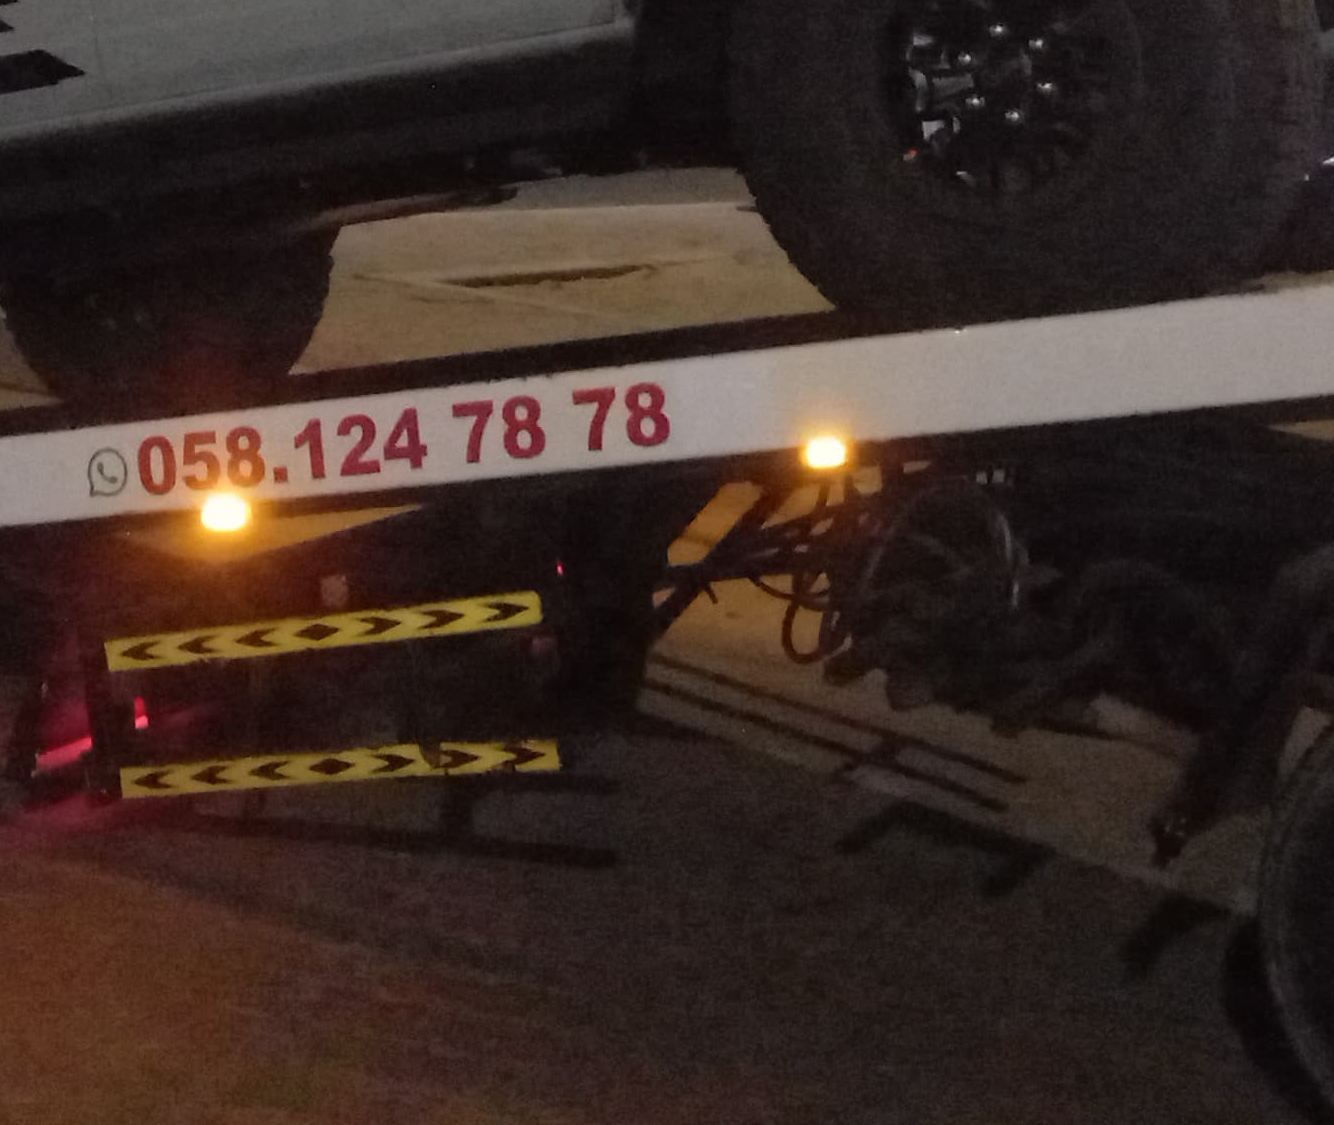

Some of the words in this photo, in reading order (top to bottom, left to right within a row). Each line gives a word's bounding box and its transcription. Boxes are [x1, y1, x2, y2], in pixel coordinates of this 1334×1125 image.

[138, 407, 428, 495] 058.124
[452, 395, 546, 463] 78
[572, 382, 670, 451] 78
